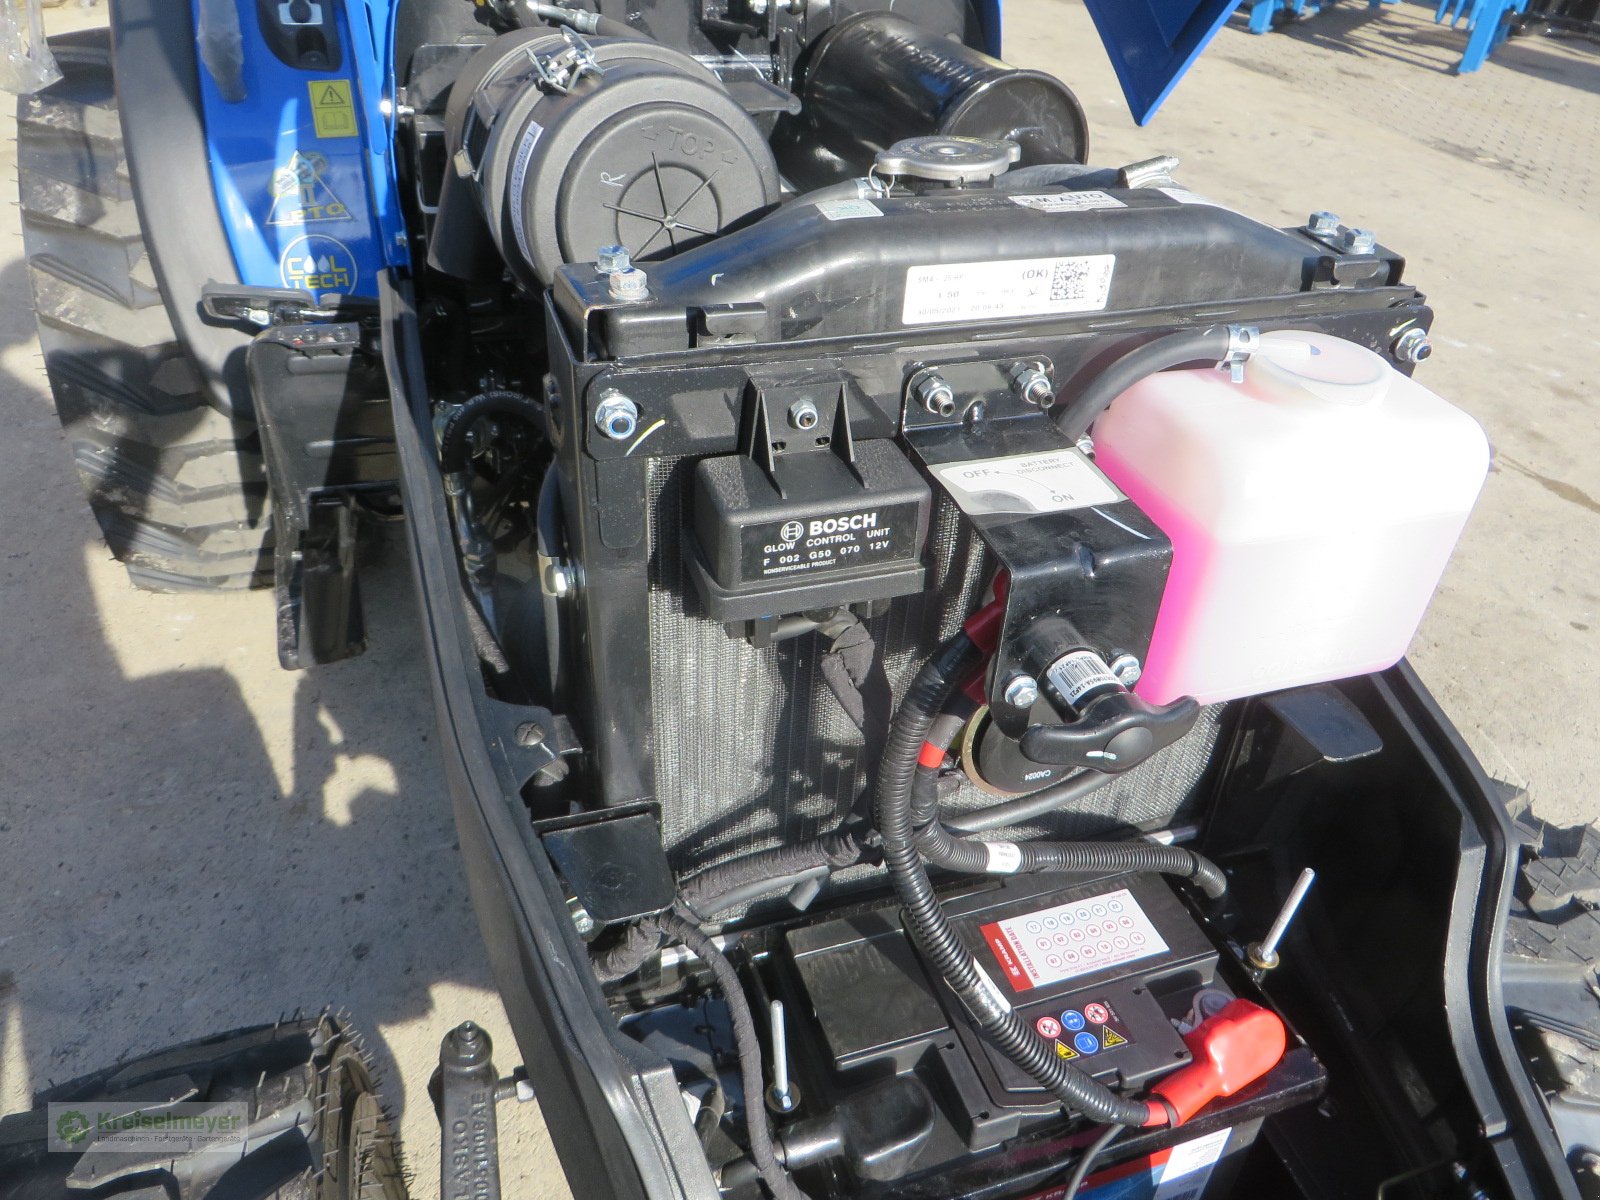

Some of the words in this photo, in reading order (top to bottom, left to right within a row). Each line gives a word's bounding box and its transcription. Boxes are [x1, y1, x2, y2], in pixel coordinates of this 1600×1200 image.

[667, 125, 715, 160] TOP
[288, 273, 349, 289] TECH
[1022, 269, 1049, 280] (OK)
[1016, 461, 1074, 475] DISCONNECT
[1020, 457, 1061, 467] BATTERY
[962, 468, 992, 479] OFF
[1052, 493, 1075, 503] ON
[809, 512, 877, 536] BOSCH
[764, 541, 796, 554] GLOW
[806, 533, 856, 548] CONTROL
[866, 527, 891, 539] UNIT
[763, 558, 771, 567] F
[779, 554, 800, 564] 002
[809, 550, 832, 560] G50
[840, 545, 861, 555] 070
[869, 540, 890, 550] 12V
[763, 562, 811, 575] NONSERVICEABLE
[811, 558, 837, 569] PRODUCT
[1024, 768, 1052, 781] CA0024
[1005, 926, 1018, 940] DATE
[1014, 940, 1040, 979] INSTALLATION
